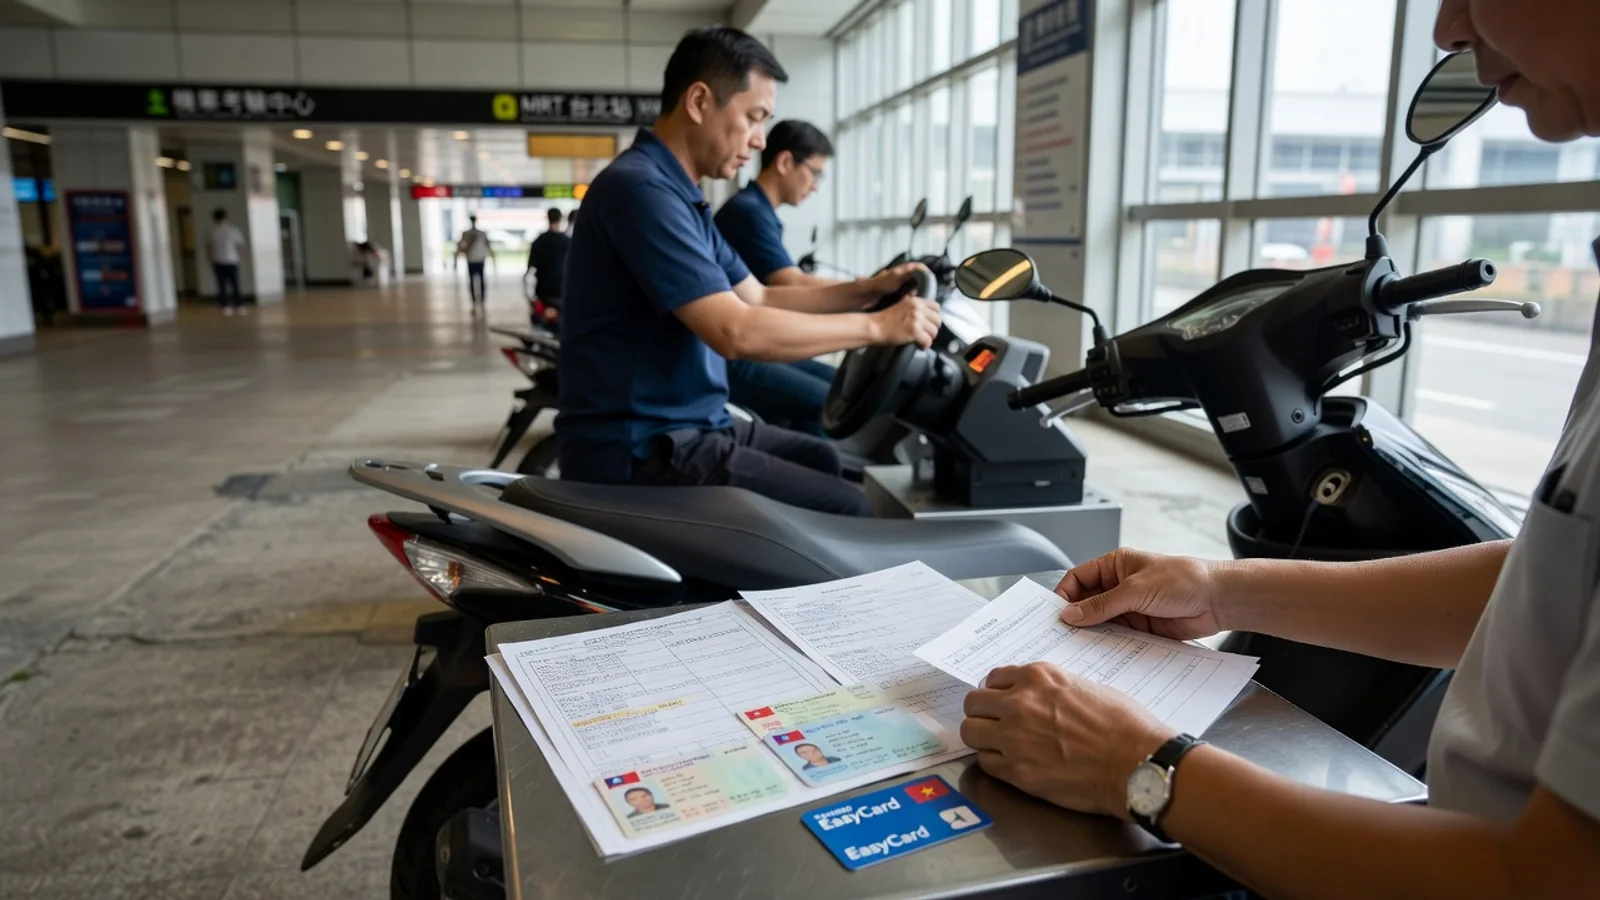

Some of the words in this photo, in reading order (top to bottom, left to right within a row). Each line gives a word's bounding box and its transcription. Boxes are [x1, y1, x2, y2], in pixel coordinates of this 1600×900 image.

[521, 94, 565, 113] MRT
[818, 796, 902, 831] EasyCard
[844, 825, 930, 861] EasyCard
